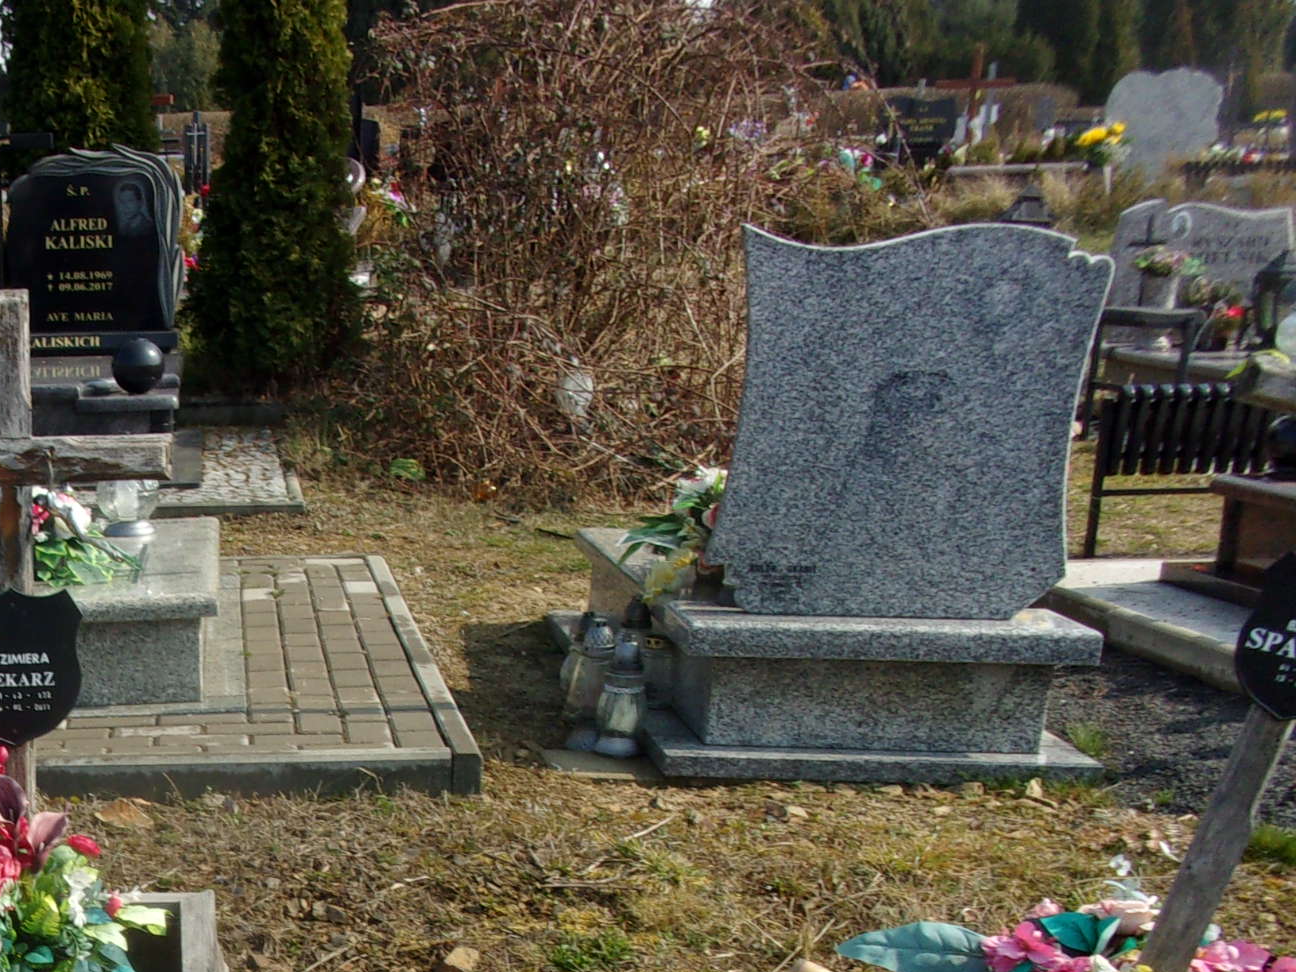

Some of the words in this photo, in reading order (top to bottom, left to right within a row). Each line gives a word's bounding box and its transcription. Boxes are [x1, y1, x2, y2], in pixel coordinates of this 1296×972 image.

[50, 218, 108, 232] ALFRED
[45, 235, 113, 250] KALISKI
[47, 312, 69, 322] AVE
[74, 311, 113, 321] MARIA
[30, 336, 101, 349] ALISKICH
